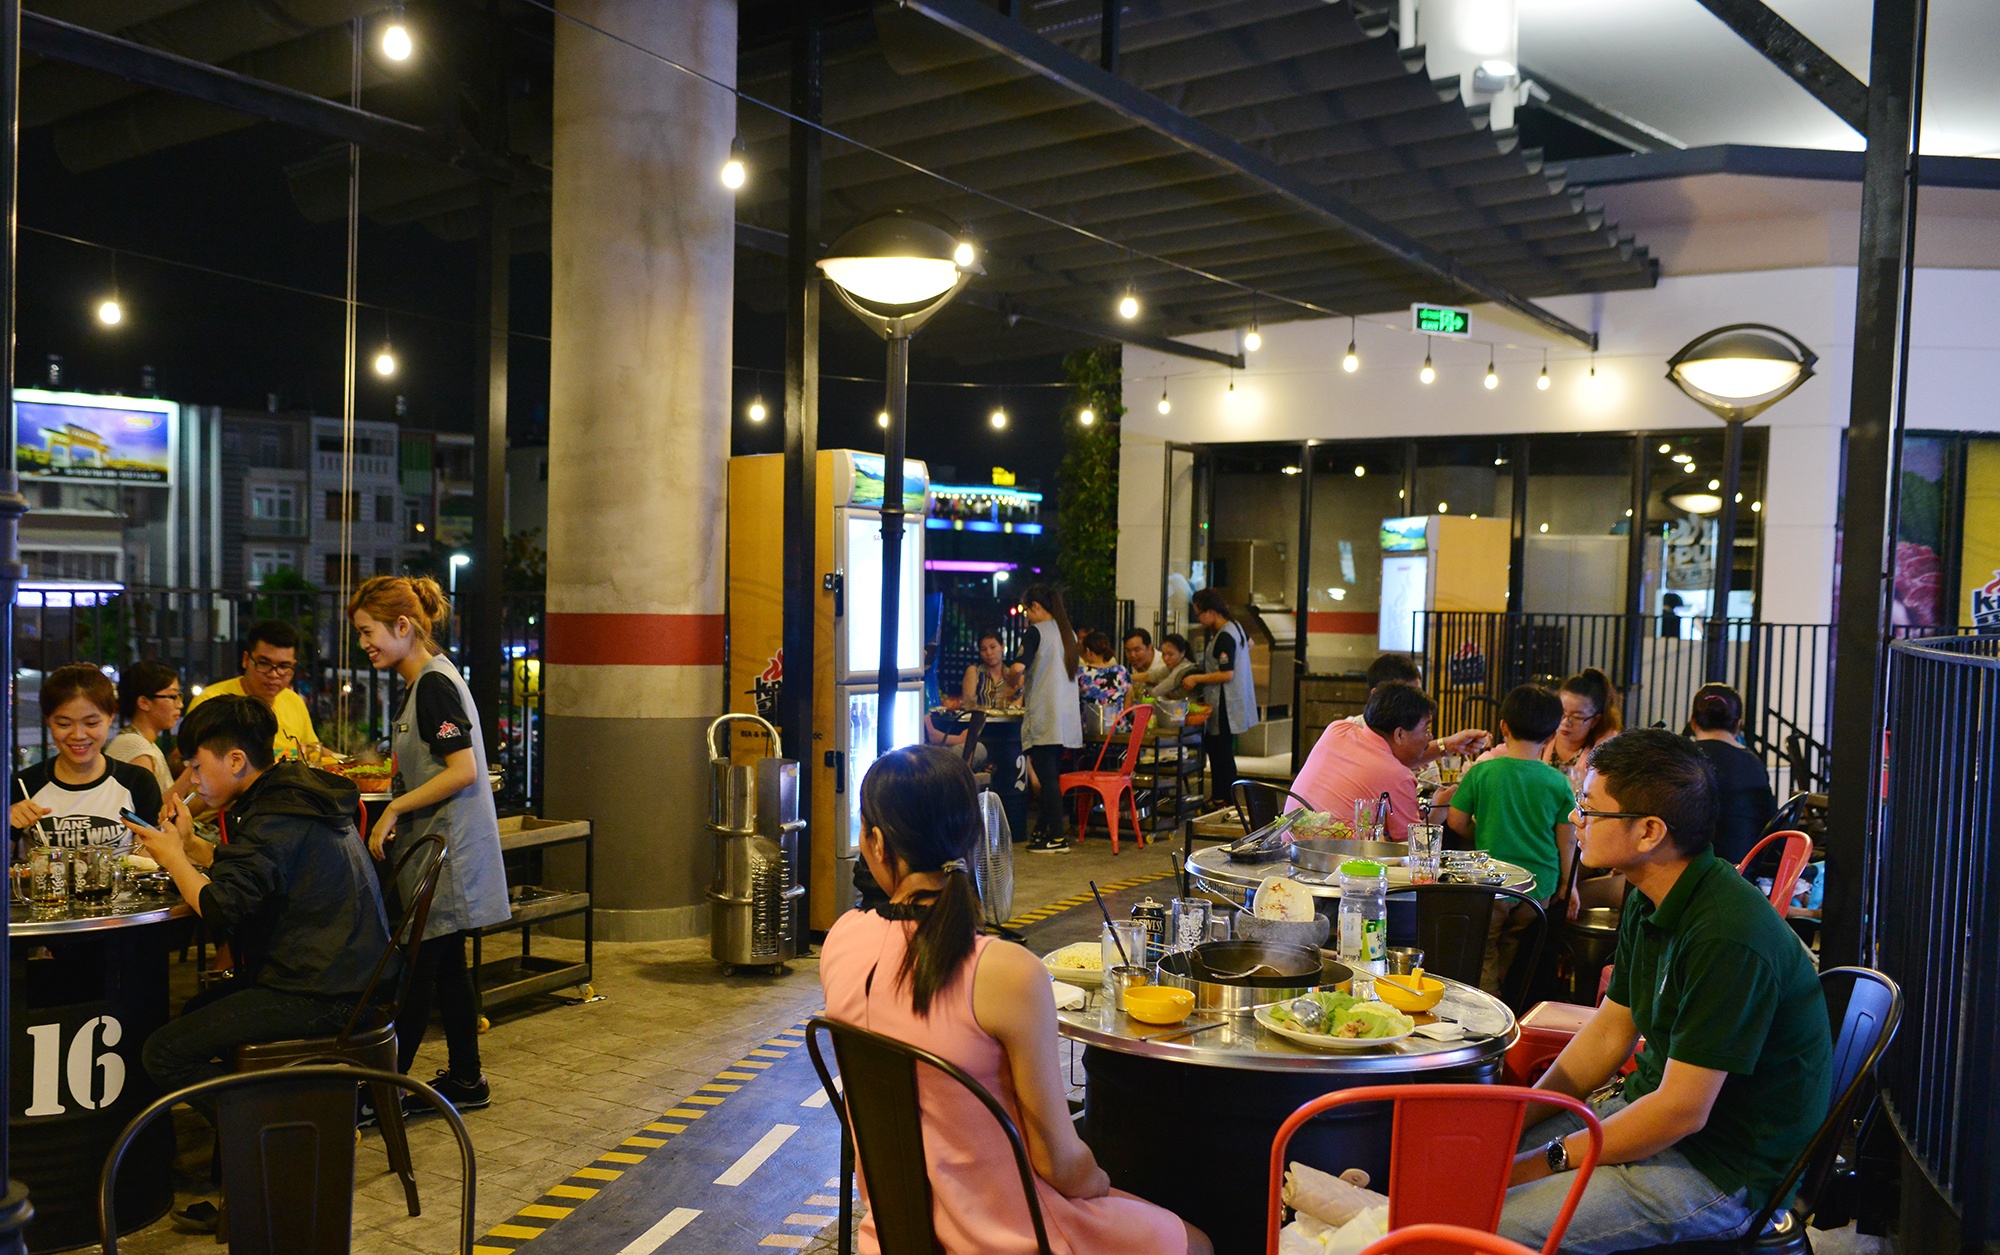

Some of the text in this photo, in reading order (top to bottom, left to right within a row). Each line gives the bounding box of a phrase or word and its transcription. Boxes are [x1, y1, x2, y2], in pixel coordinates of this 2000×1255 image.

[53, 817, 92, 831] VANS
[54, 829, 85, 848] THE
[24, 1015, 126, 1117] 16
